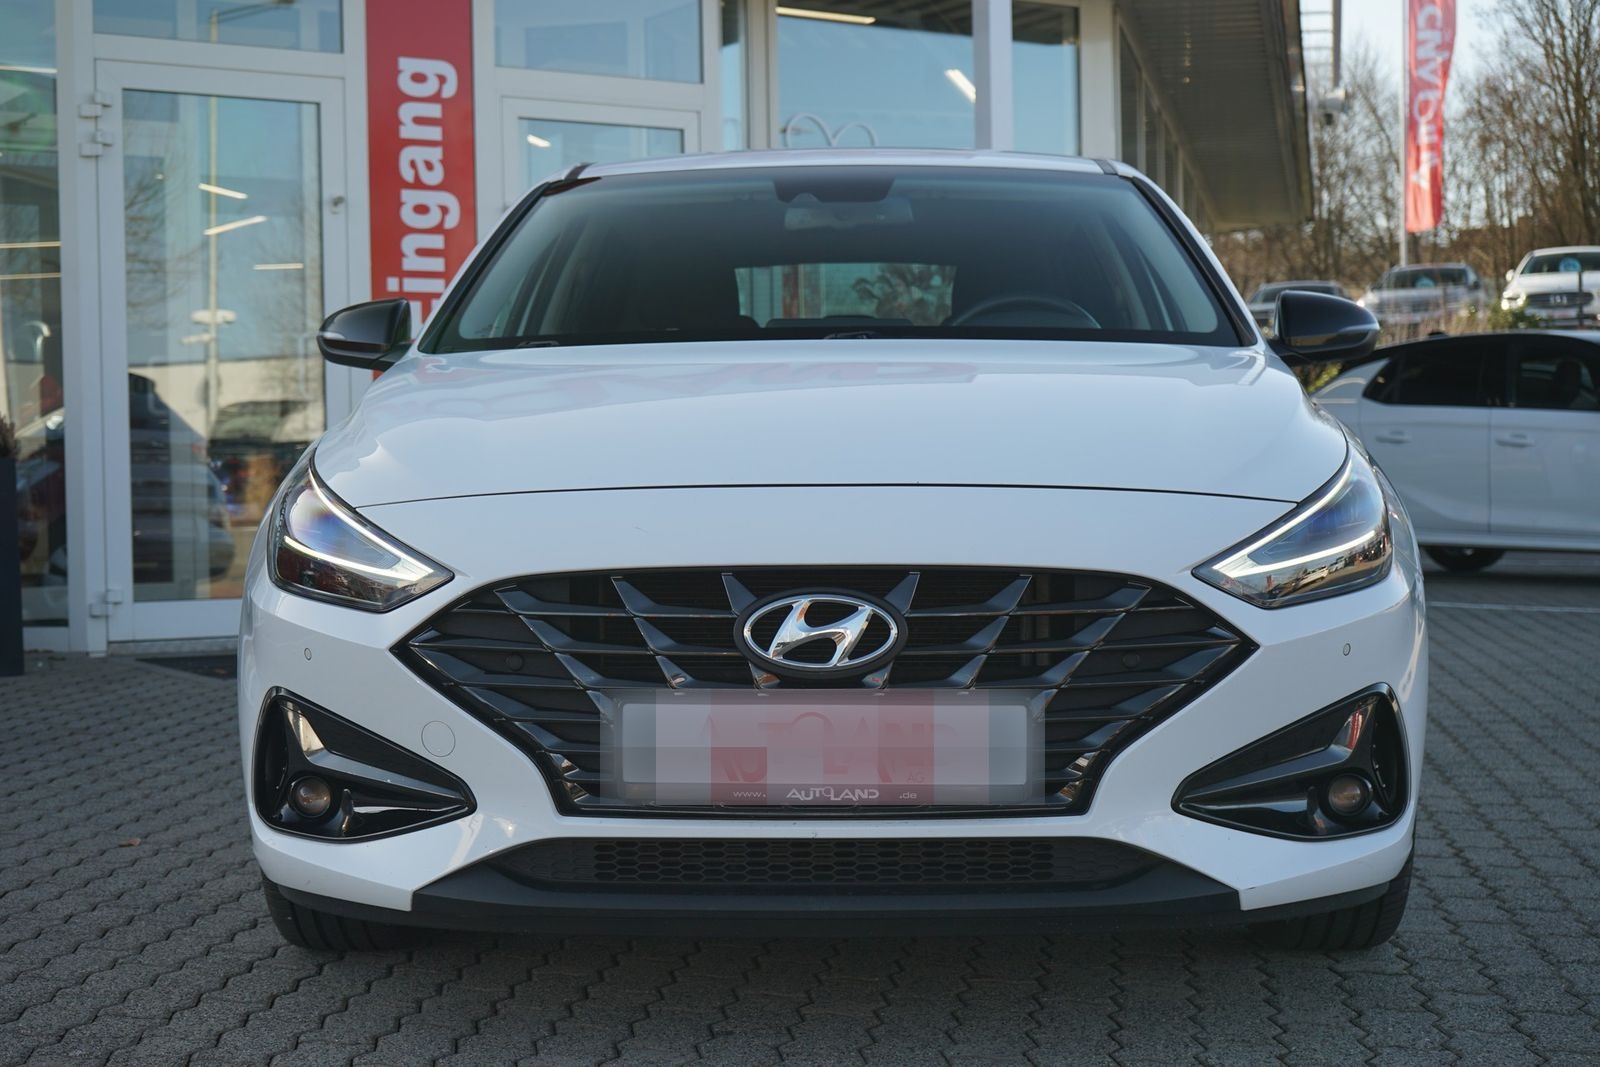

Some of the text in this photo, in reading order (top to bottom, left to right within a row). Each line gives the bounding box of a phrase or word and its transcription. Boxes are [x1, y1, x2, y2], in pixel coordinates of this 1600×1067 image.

[907, 771, 925, 784] AG
[733, 786, 917, 801] www. AUTOLAND .de
